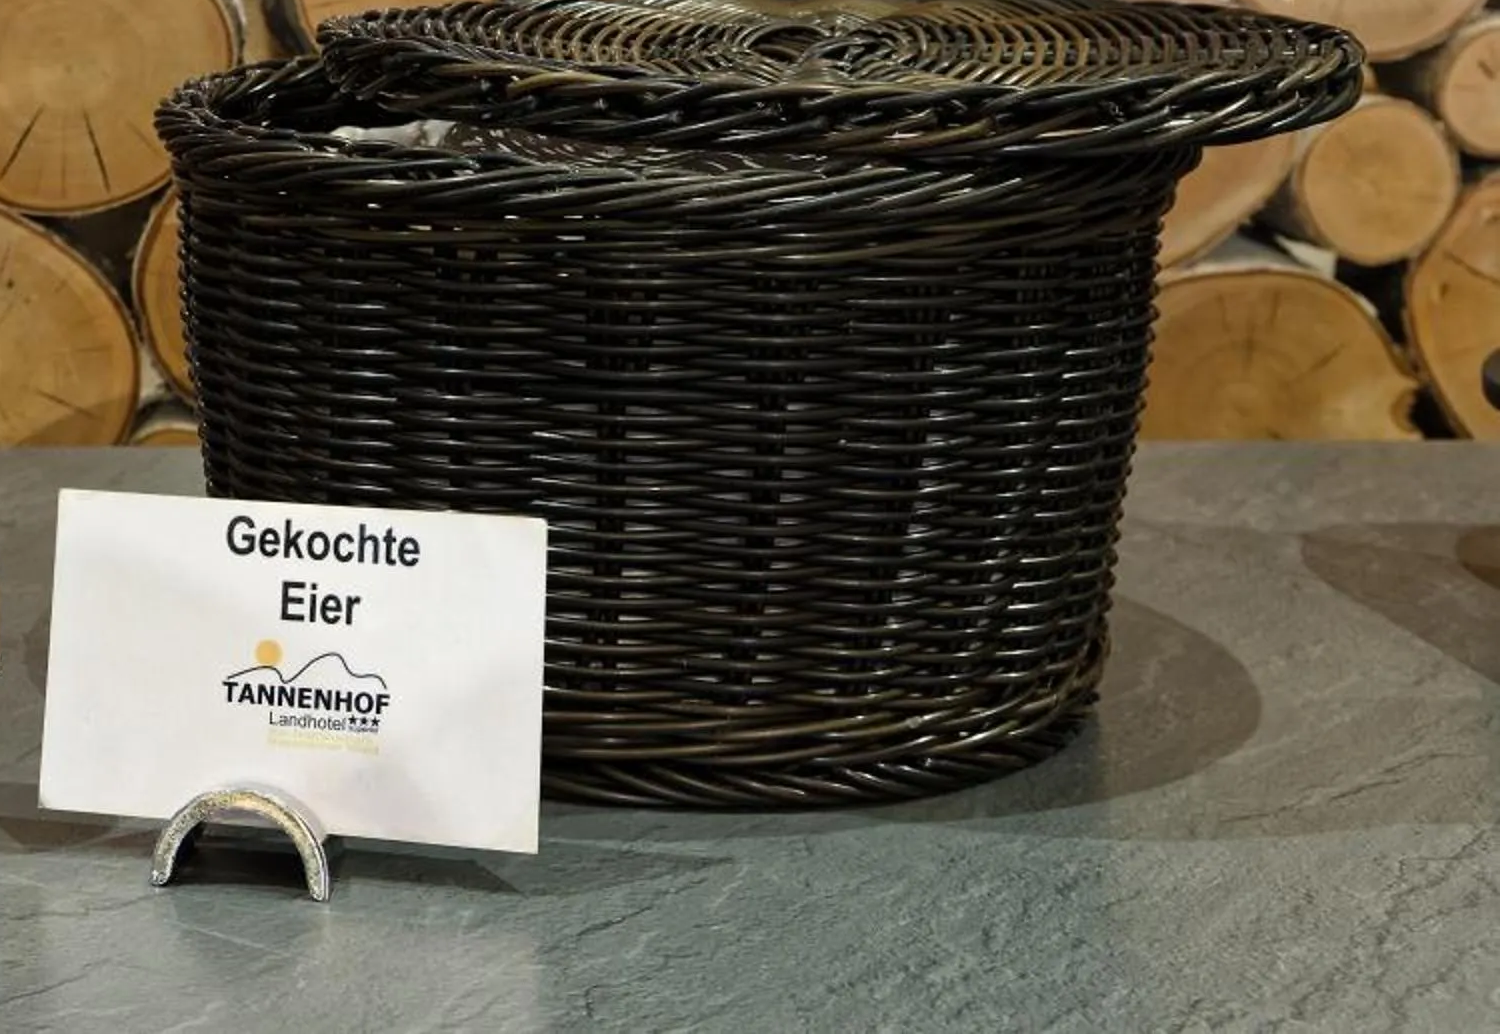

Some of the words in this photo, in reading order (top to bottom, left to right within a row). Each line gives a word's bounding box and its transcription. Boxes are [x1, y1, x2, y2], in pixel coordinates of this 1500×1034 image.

[226, 515, 421, 567] Gekochte
[280, 580, 361, 625] Eier
[222, 681, 390, 714] TANNENHOF
[268, 711, 346, 731] Landhotel
